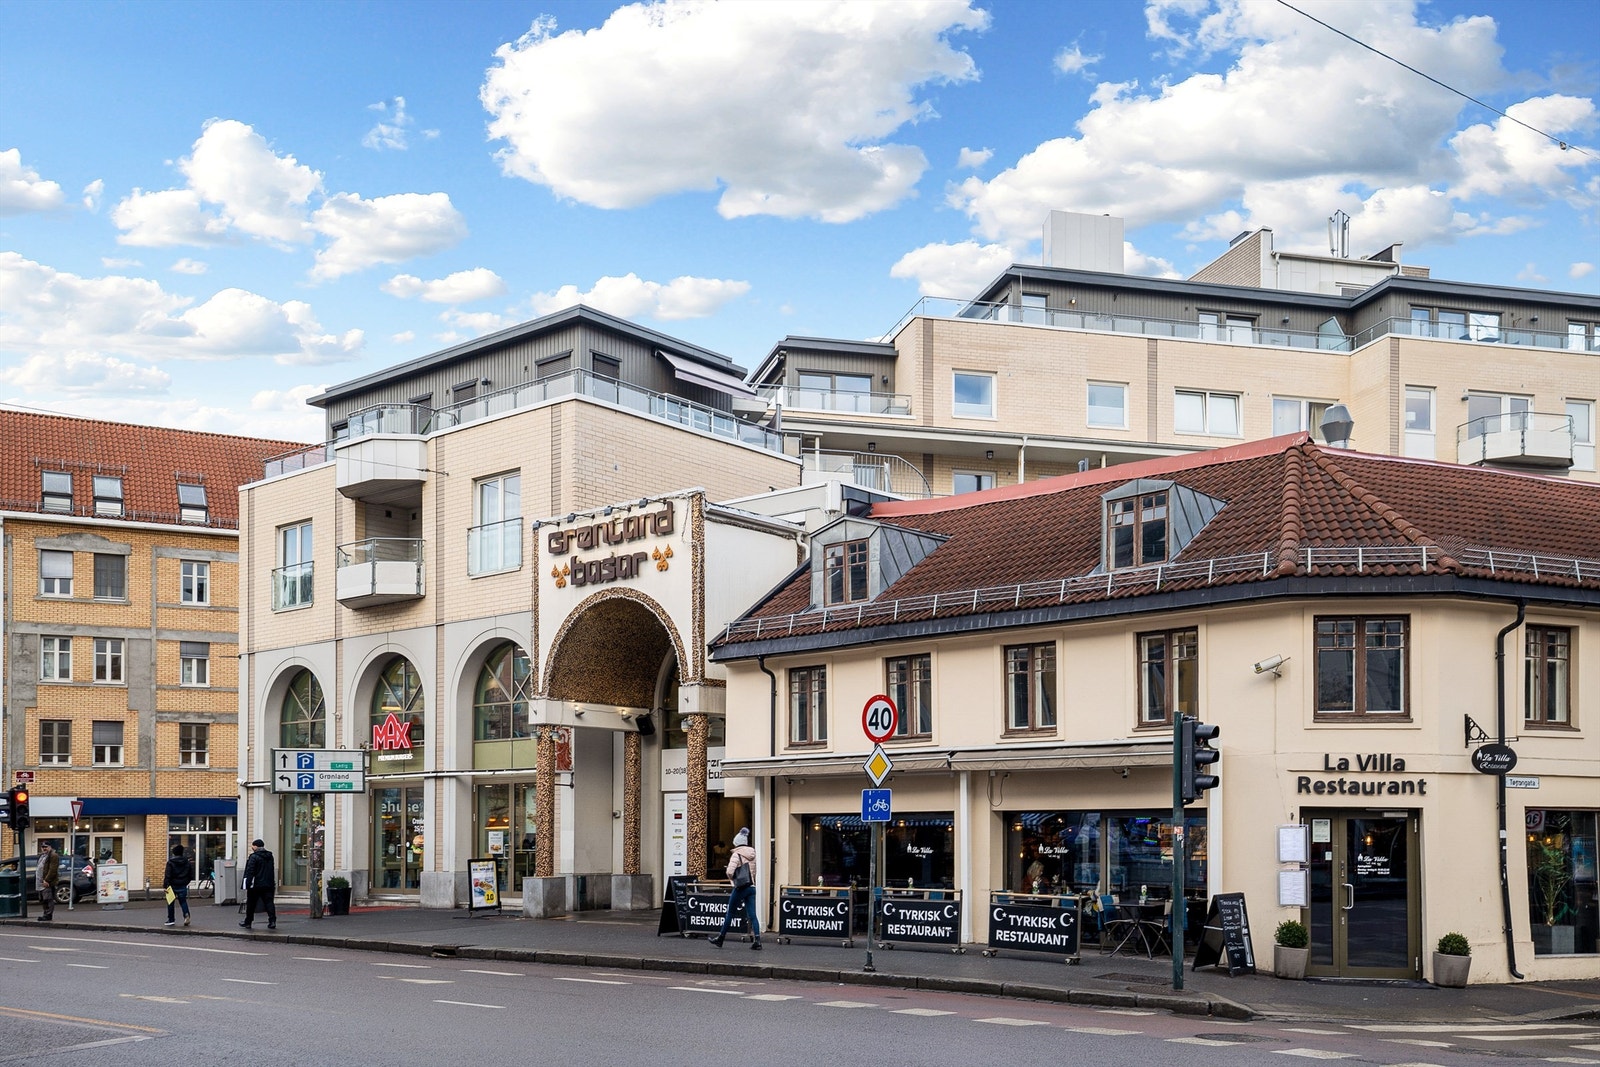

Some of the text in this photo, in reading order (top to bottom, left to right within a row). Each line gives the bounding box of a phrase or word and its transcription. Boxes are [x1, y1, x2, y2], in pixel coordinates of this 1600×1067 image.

[868, 707, 892, 731] 40
[373, 712, 412, 751] MAX
[1324, 753, 1406, 772] La Villa
[1494, 753, 1511, 762] Villa
[1297, 776, 1427, 795] Restaurant
[699, 902, 730, 913] TYRKIS
[796, 905, 835, 917] TYRKISK
[690, 916, 742, 928] RESTAURNT
[898, 909, 941, 921] TYRKISK
[1008, 914, 1057, 929] TYRKISK
[785, 918, 844, 931] RESTAURANT
[887, 924, 952, 938] RESTAURANT
[996, 929, 1069, 946] RESTAURANT
